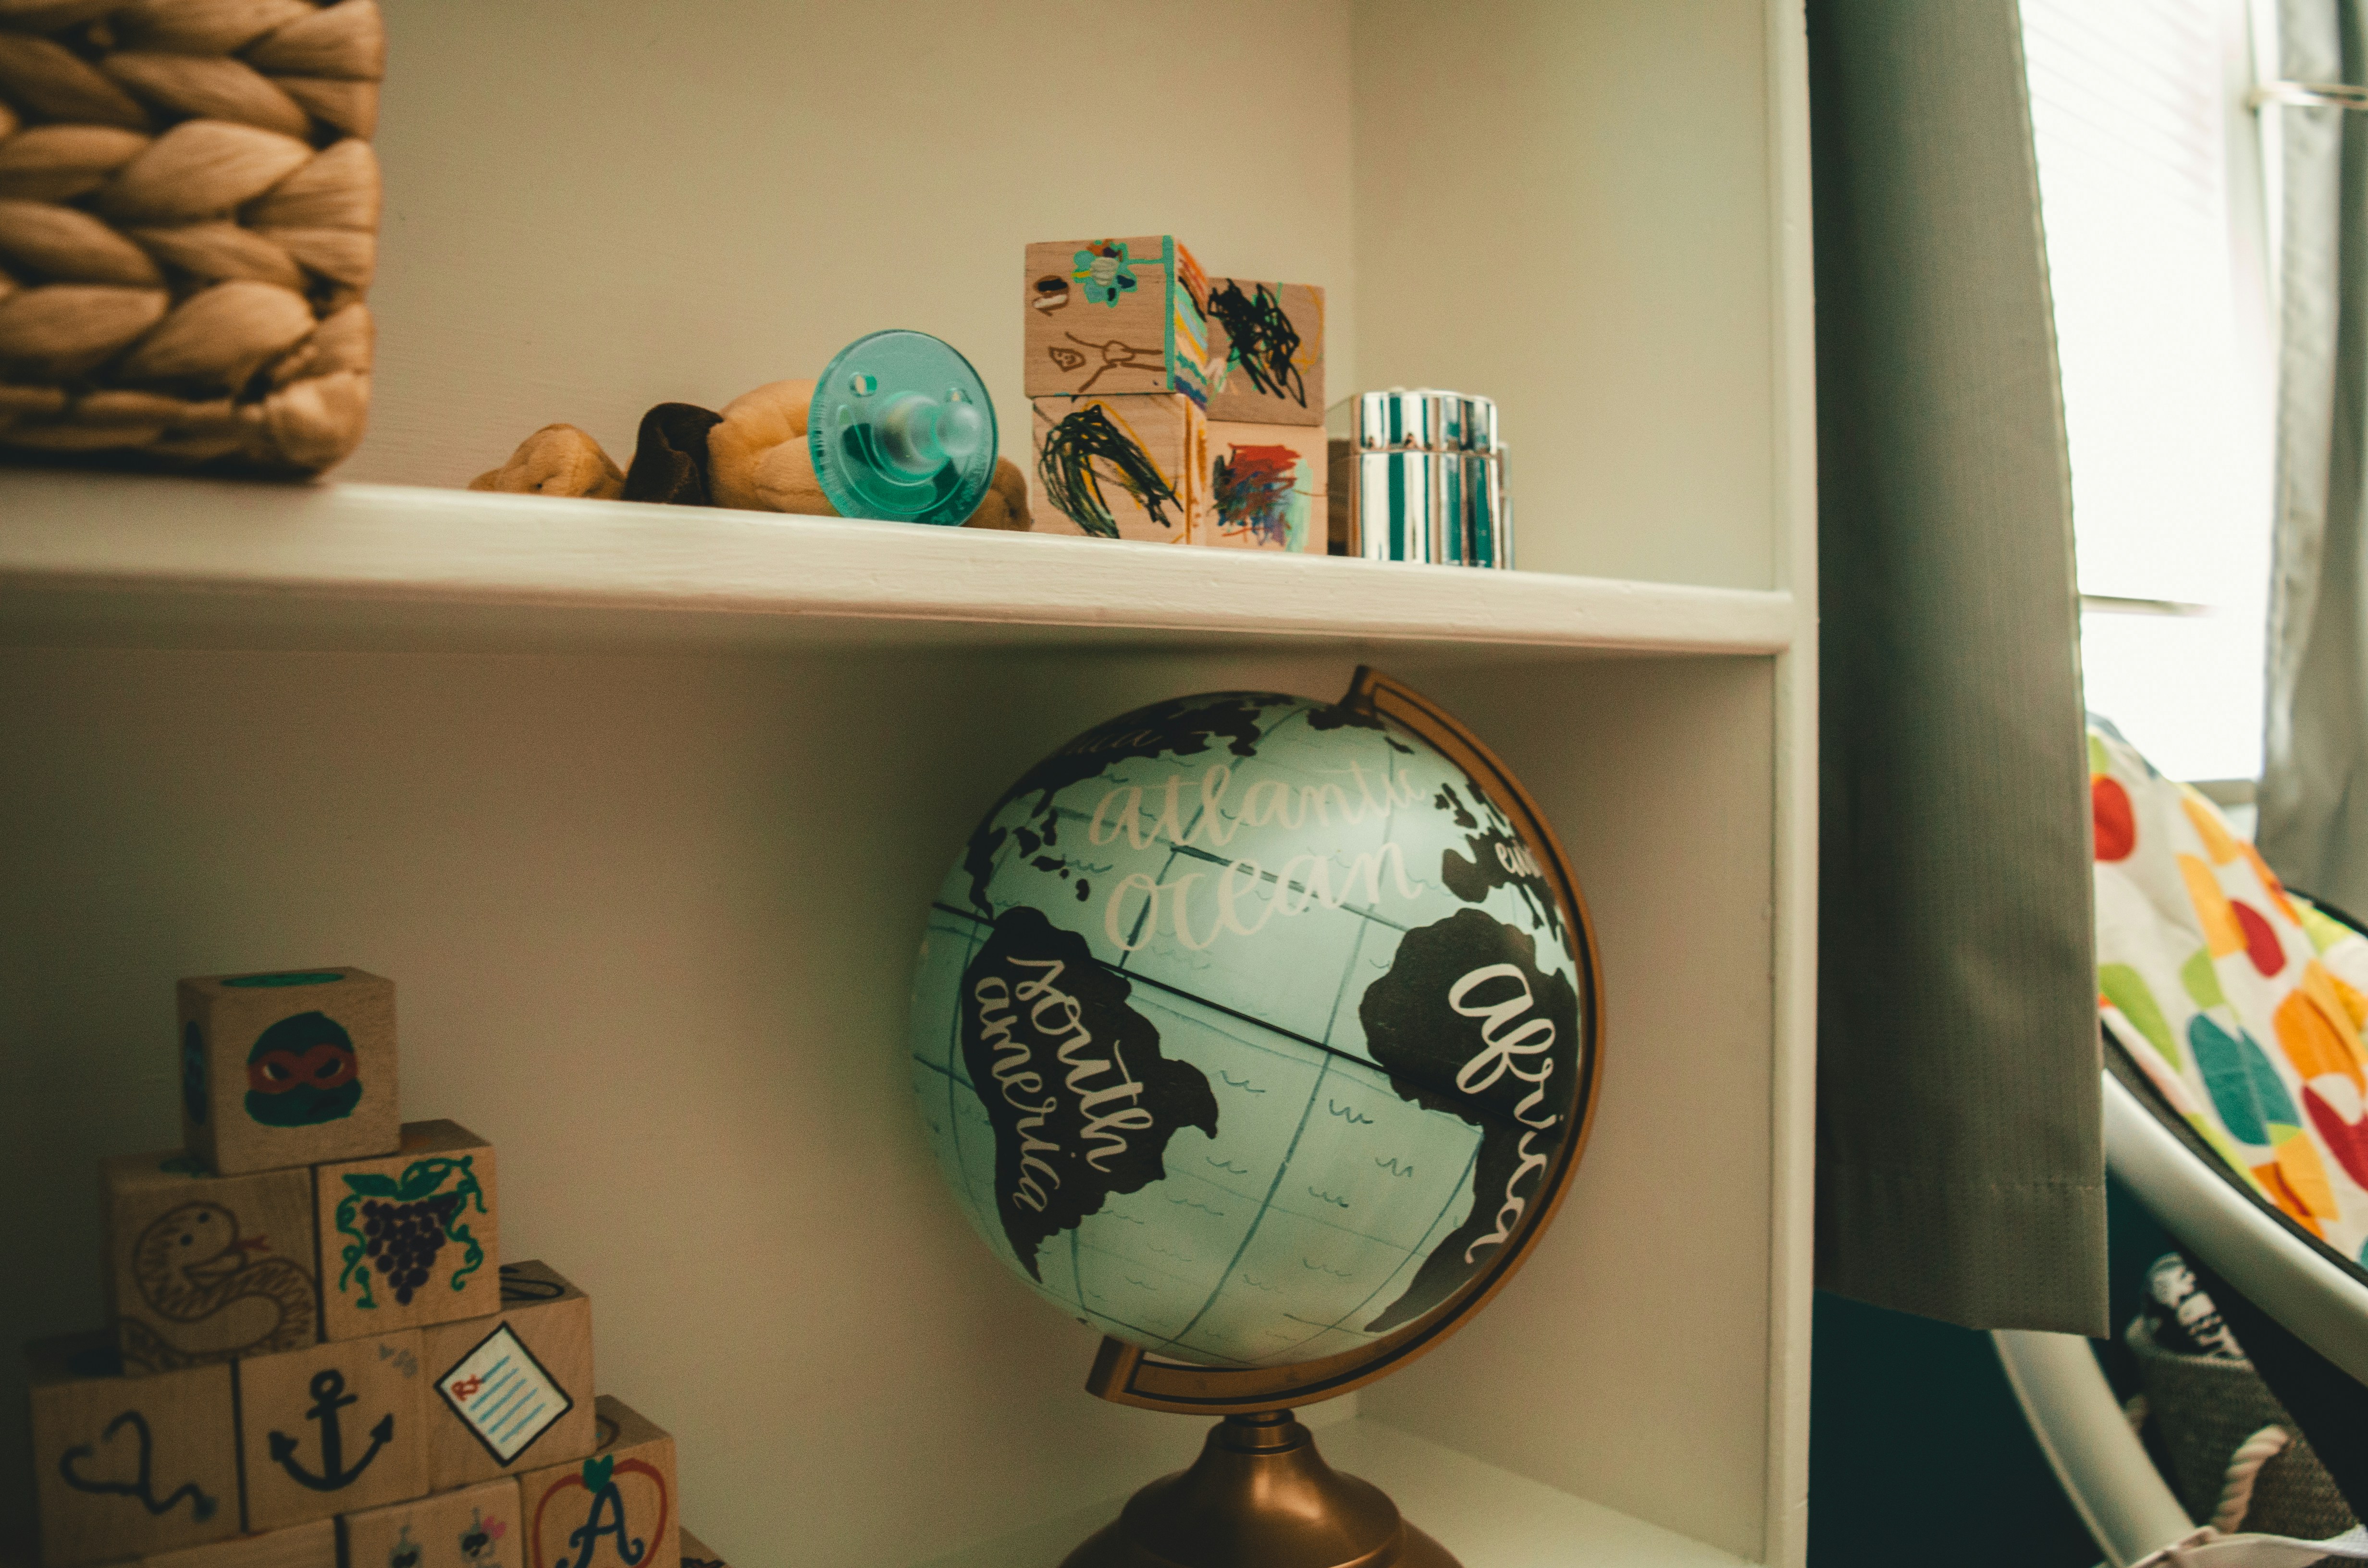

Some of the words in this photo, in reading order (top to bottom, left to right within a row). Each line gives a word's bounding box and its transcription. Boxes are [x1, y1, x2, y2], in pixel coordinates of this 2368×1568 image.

[1089, 760, 1426, 850] atlantic
[1104, 842, 1423, 951] ocean
[974, 976, 1076, 1212] america
[1007, 956, 1153, 1173] south
[1448, 963, 1564, 1264] africa
